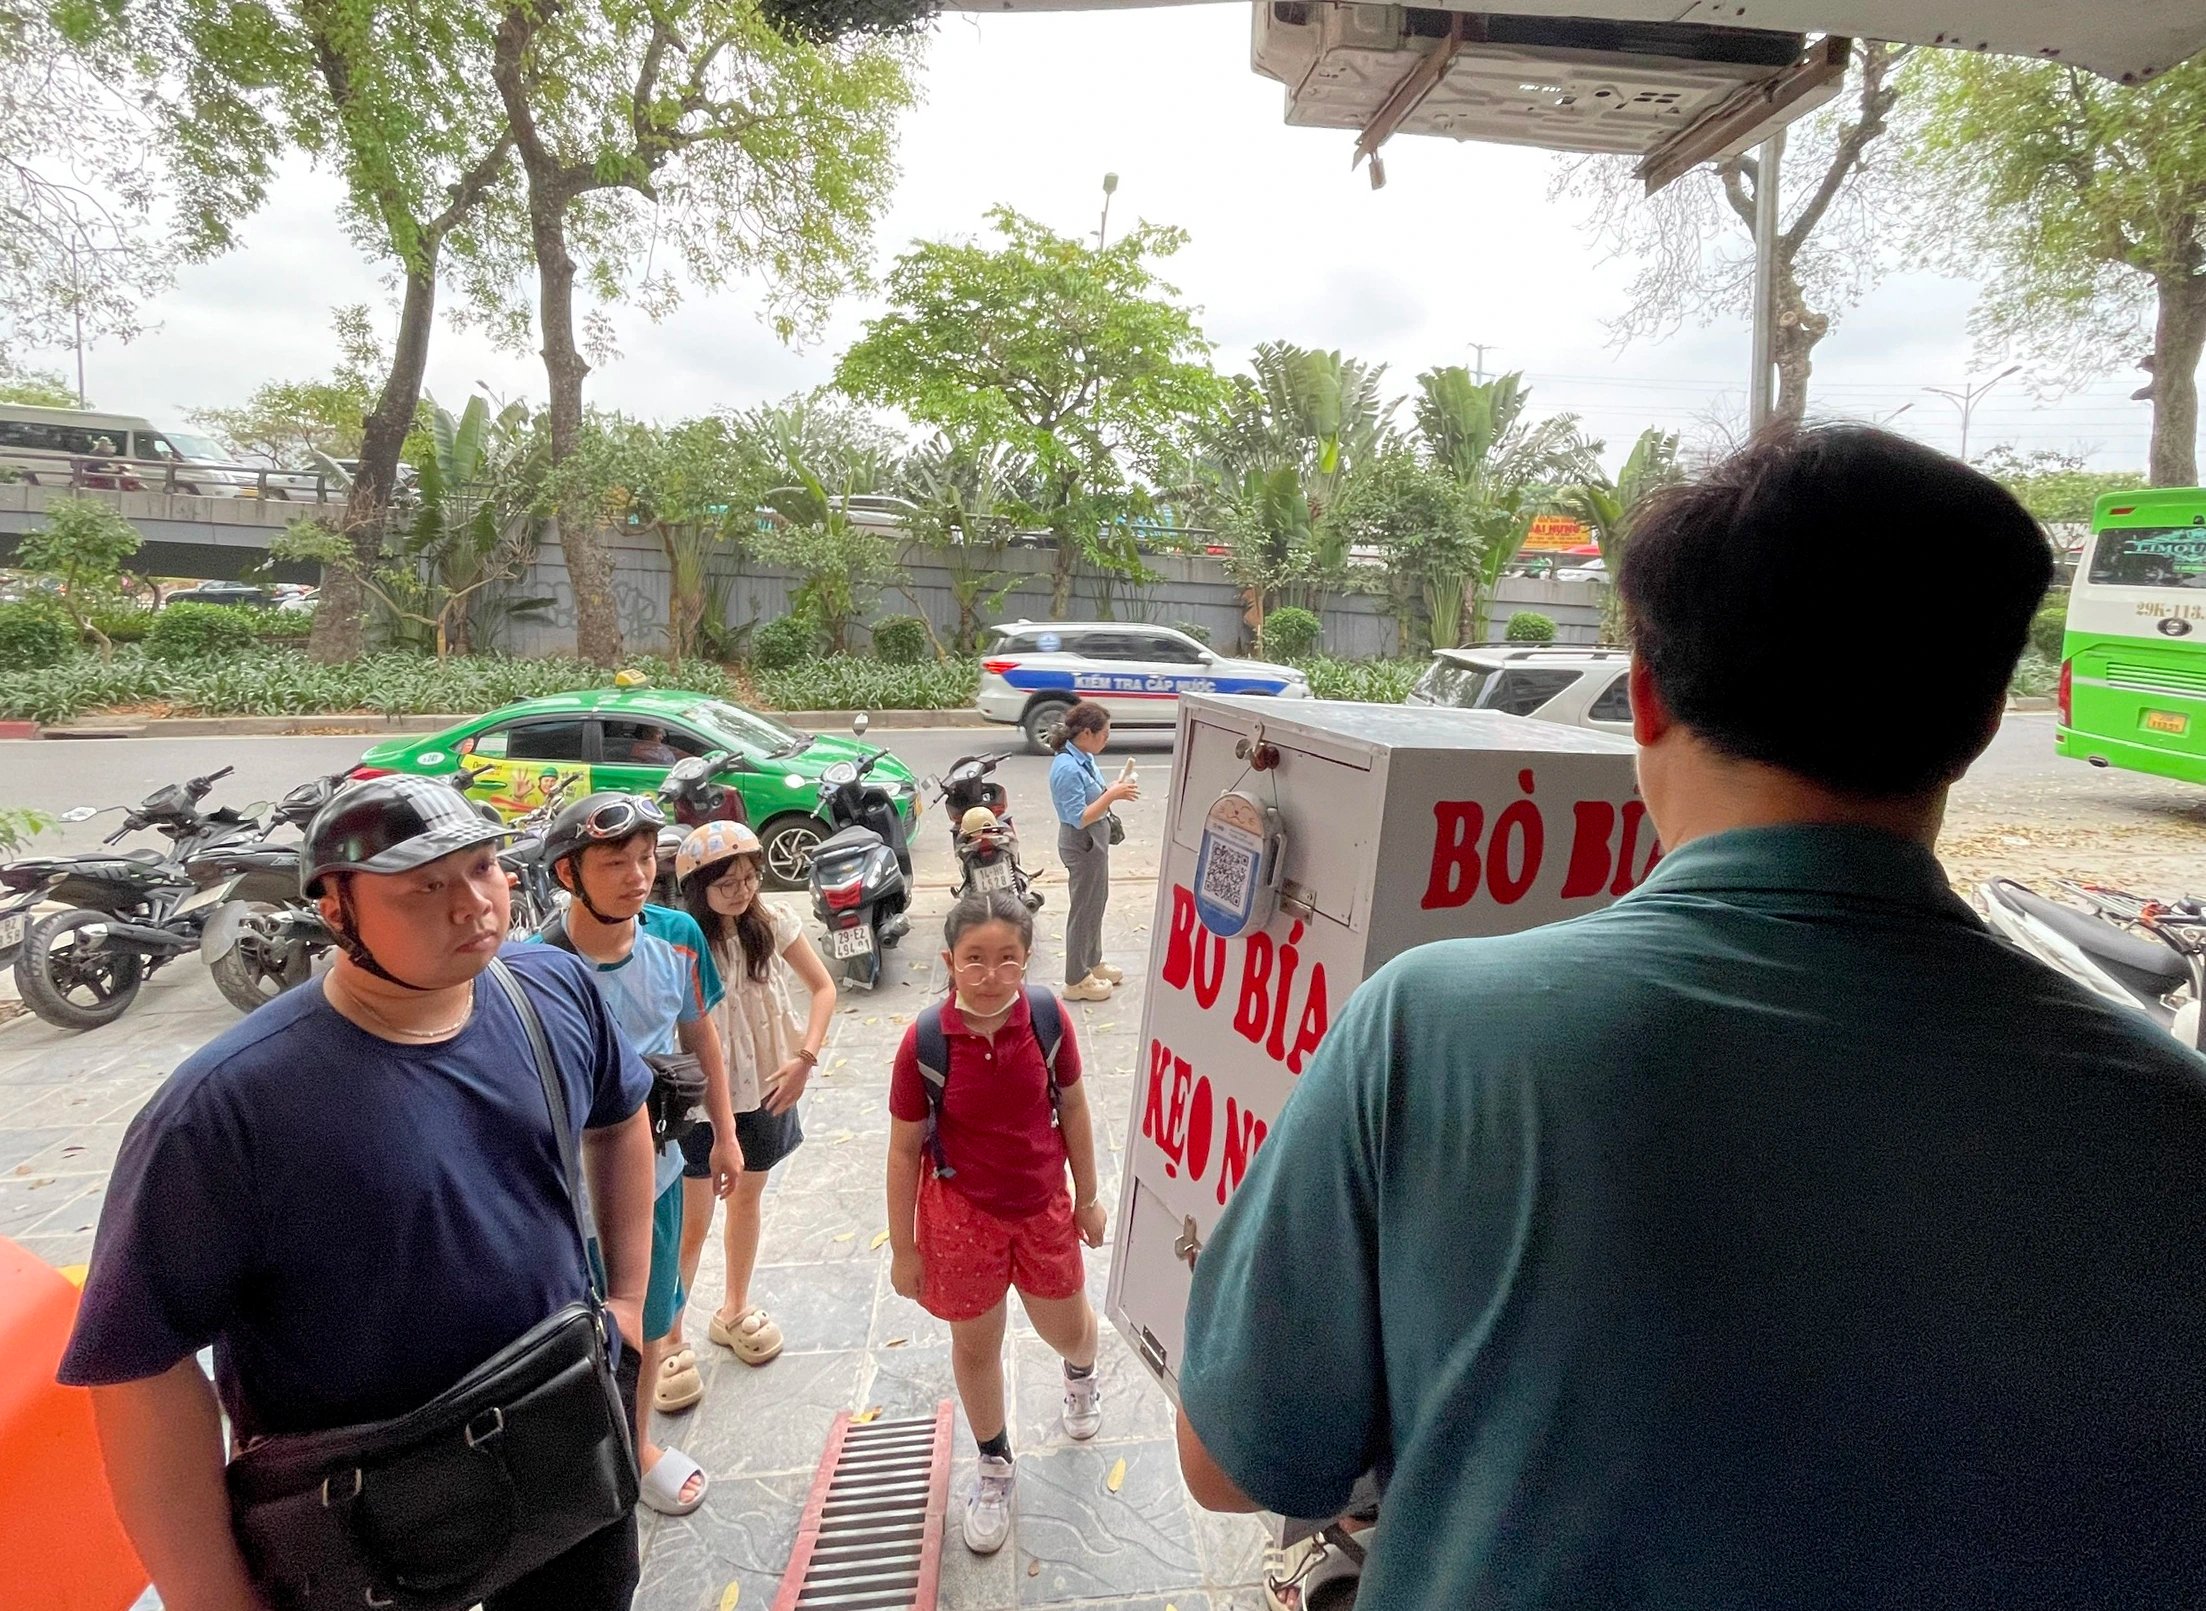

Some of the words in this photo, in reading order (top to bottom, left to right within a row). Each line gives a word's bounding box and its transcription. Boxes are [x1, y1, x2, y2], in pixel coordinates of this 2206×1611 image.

[1113, 678, 1143, 691] TRA
[1144, 676, 1174, 692] CẤP
[1420, 768, 1544, 910] BÒ
[838, 928, 865, 944] 29-E2
[1233, 919, 1328, 1074] BÍA
[1143, 1039, 1213, 1181] KẸO
